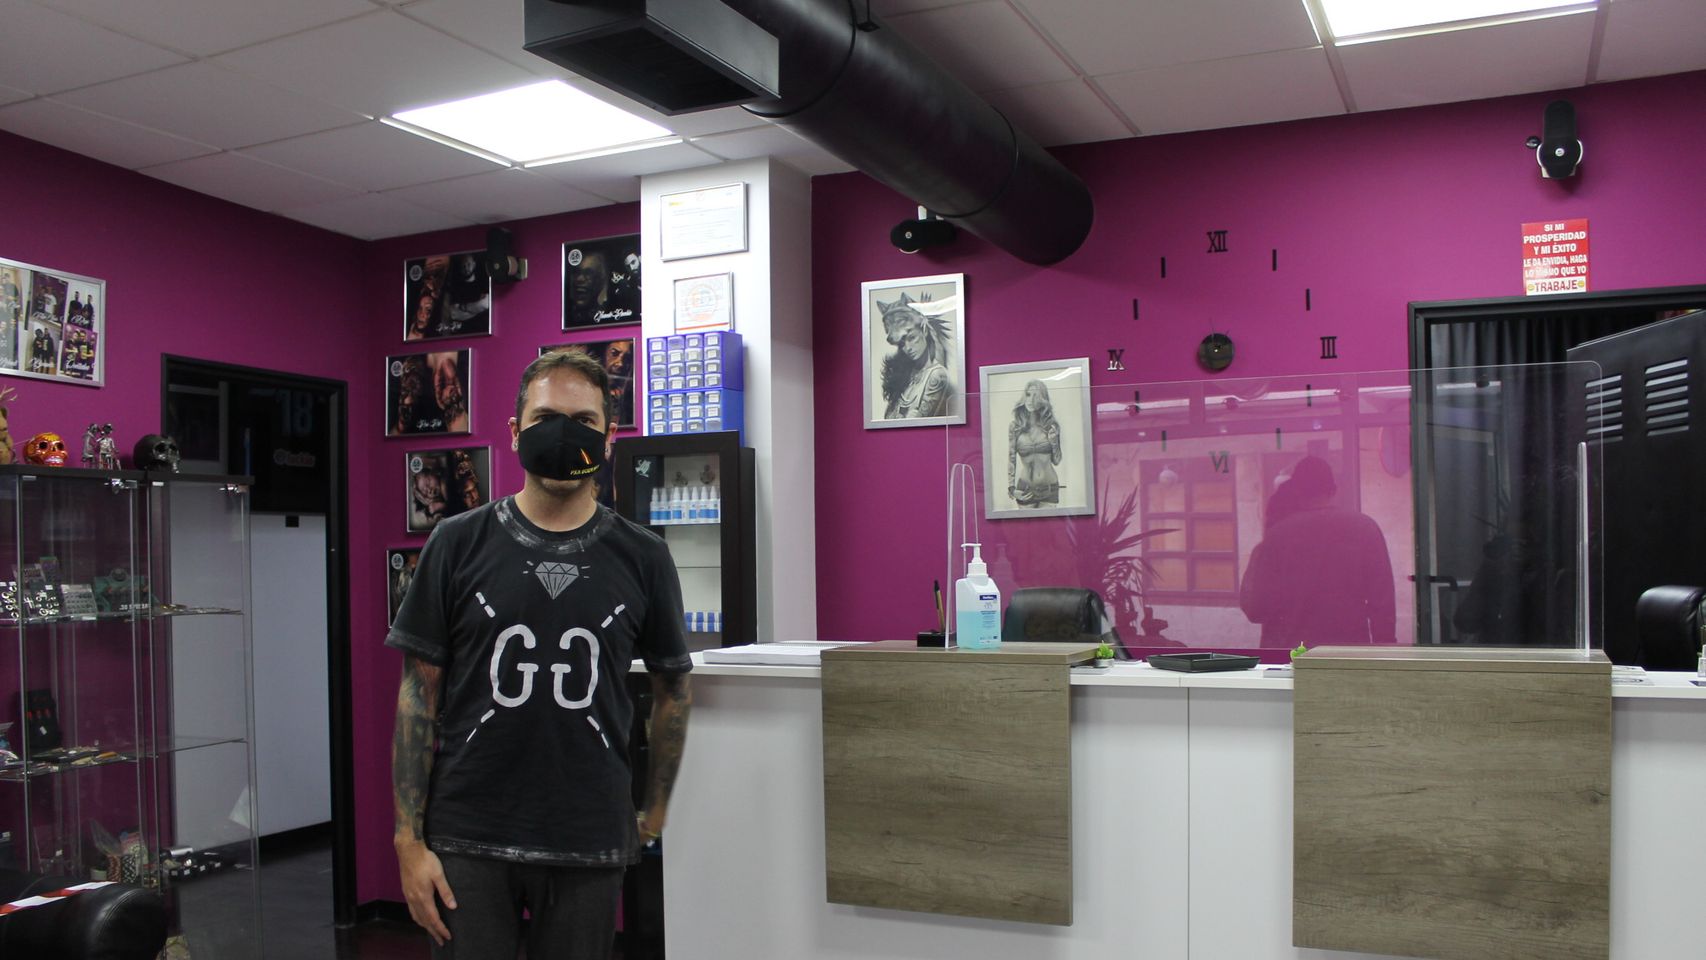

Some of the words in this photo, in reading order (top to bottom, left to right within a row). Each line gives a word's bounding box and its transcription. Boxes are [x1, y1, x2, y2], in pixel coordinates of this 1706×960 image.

[1207, 230, 1228, 253] XII
[1523, 231, 1586, 243] PROSPERIDAD
[1533, 246, 1539, 255] Y
[1541, 245, 1550, 254] MI
[1553, 242, 1576, 253] ÉXITO
[1523, 259, 1531, 267] LE
[1560, 266, 1576, 276] QUE
[1577, 265, 1586, 274] YO
[1535, 279, 1577, 292] TRABAJE
[1320, 336, 1337, 359] III
[1107, 349, 1125, 371] IX
[1209, 451, 1229, 473] VI
